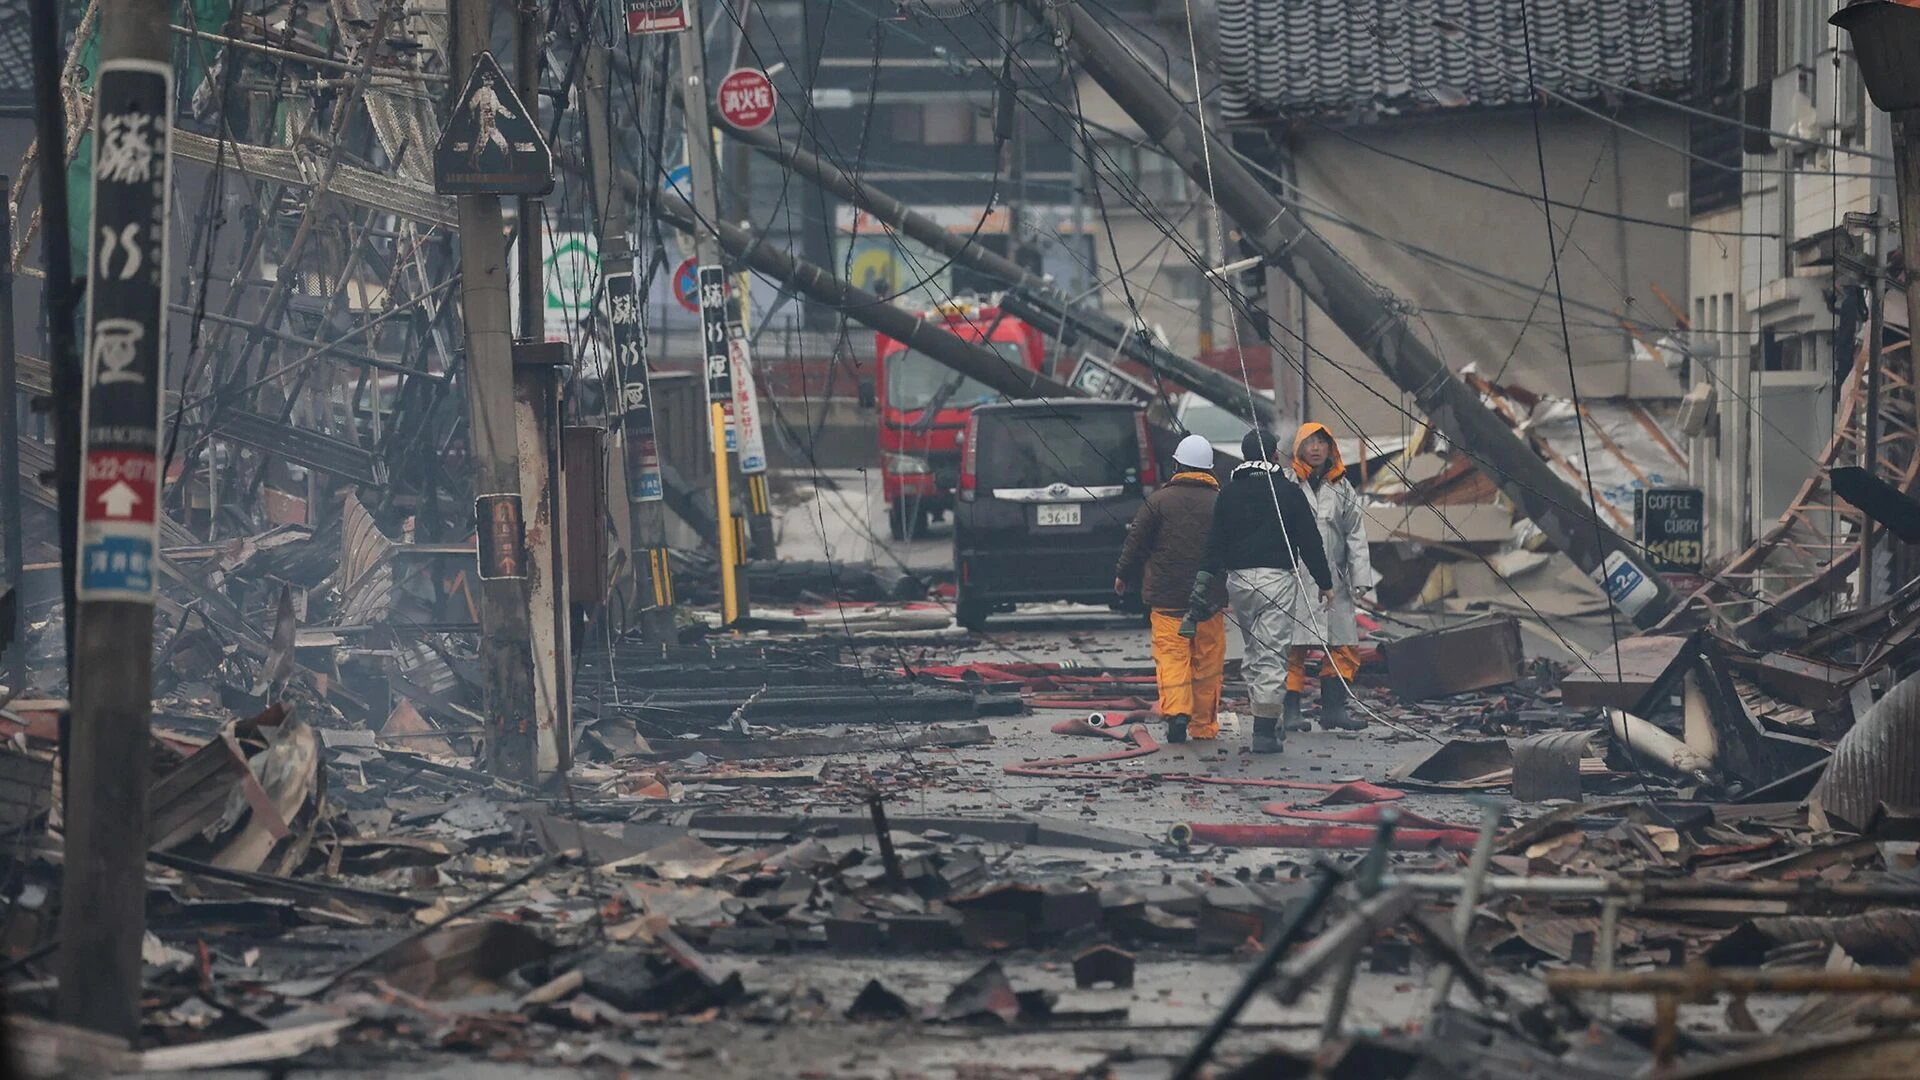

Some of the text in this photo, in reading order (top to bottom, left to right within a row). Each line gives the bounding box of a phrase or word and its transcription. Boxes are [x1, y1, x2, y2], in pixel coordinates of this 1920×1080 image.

[723, 86, 770, 113] 消火栓
[1648, 495, 1691, 509] COFFEE
[1048, 512, 1079, 523] 96-18
[1670, 509, 1678, 518] &
[1664, 519, 1700, 533] CURRY
